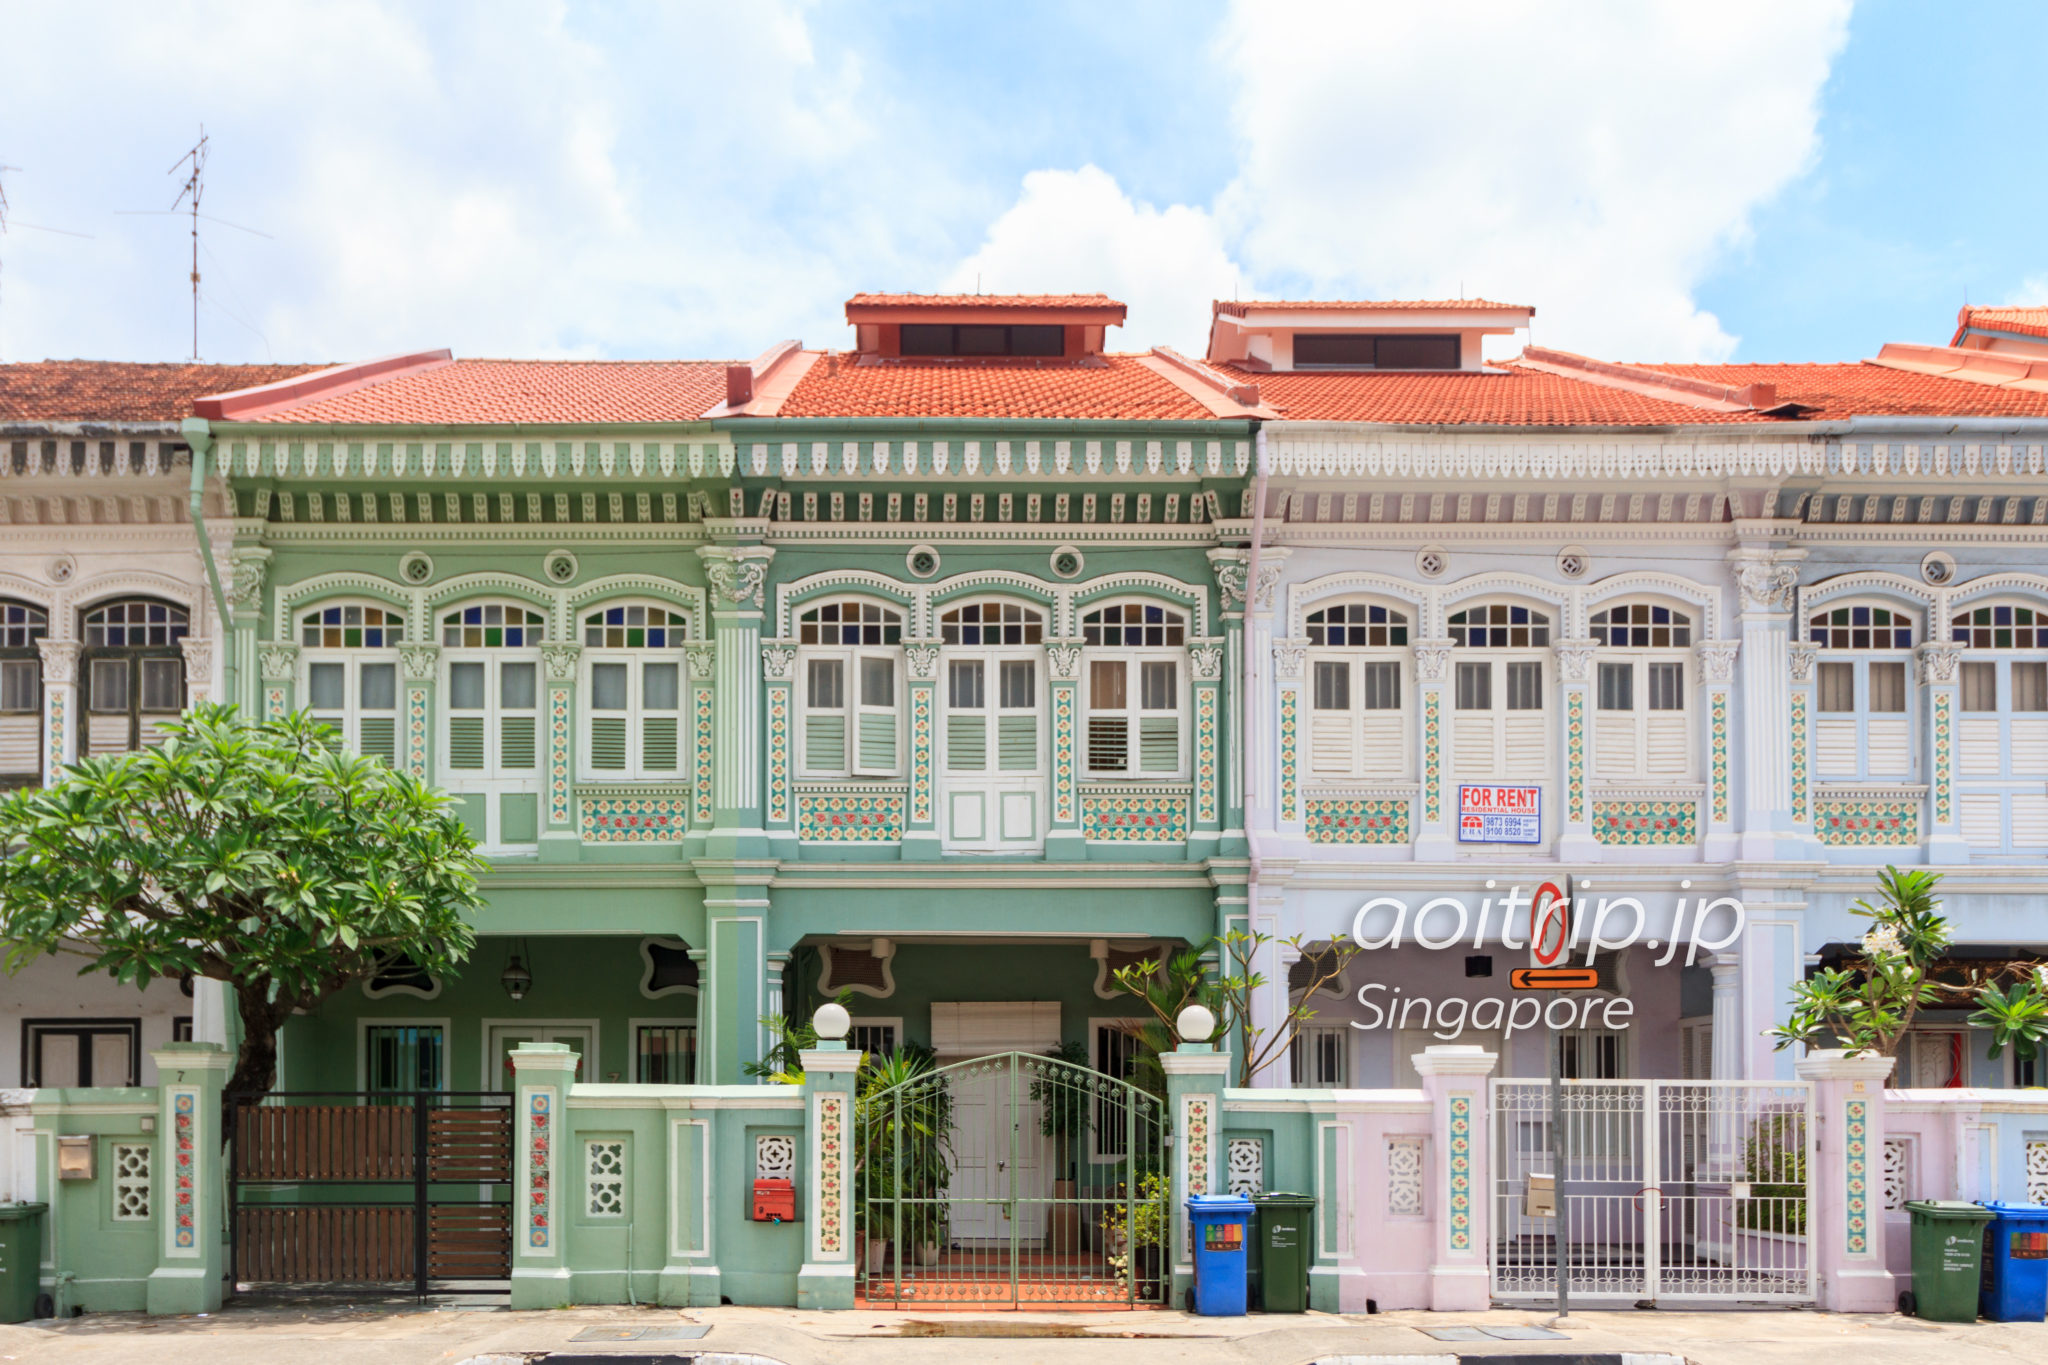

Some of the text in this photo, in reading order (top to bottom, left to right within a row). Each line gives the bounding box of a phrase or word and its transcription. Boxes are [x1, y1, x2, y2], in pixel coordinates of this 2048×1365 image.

[1462, 787, 1537, 807] FOR RENT
[1486, 817, 1503, 826] 9873
[1504, 817, 1521, 827] 6994
[1486, 827, 1503, 835] 9100
[1504, 827, 1521, 836] 8520
[176, 1070, 185, 1082] 7
[829, 1072, 834, 1080] 9
